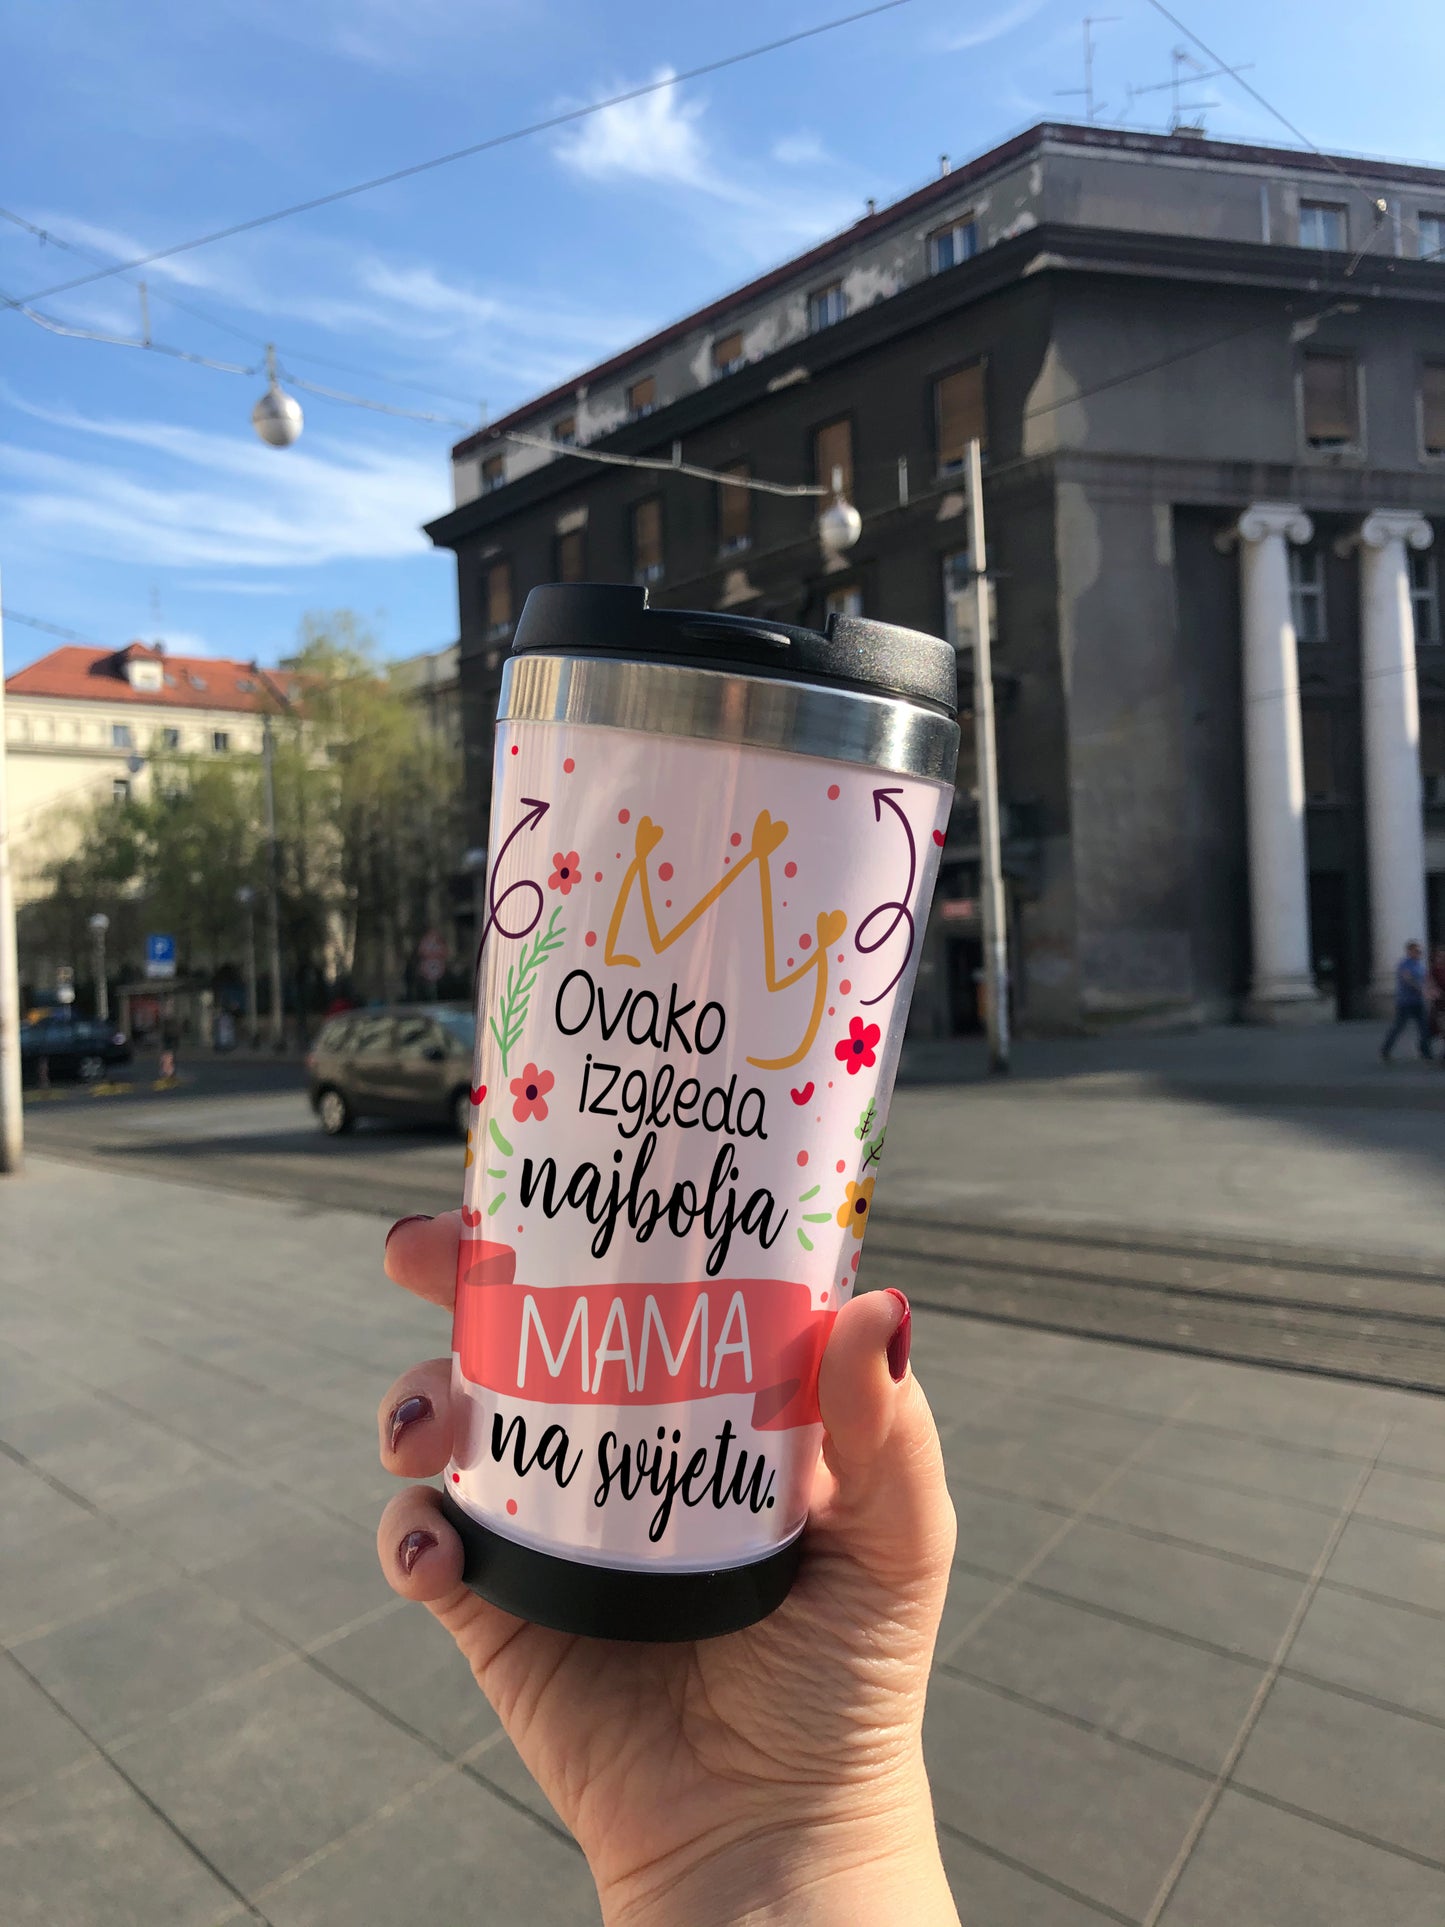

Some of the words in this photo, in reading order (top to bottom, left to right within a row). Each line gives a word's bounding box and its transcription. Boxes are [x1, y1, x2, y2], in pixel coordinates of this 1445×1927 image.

[555, 968, 726, 1055] Ovako
[578, 1053, 768, 1141] izgleda
[519, 1130, 789, 1277] najbolja
[517, 1291, 753, 1395] MAMA
[491, 1412, 584, 1489] na
[593, 1419, 776, 1543] svijetu.
